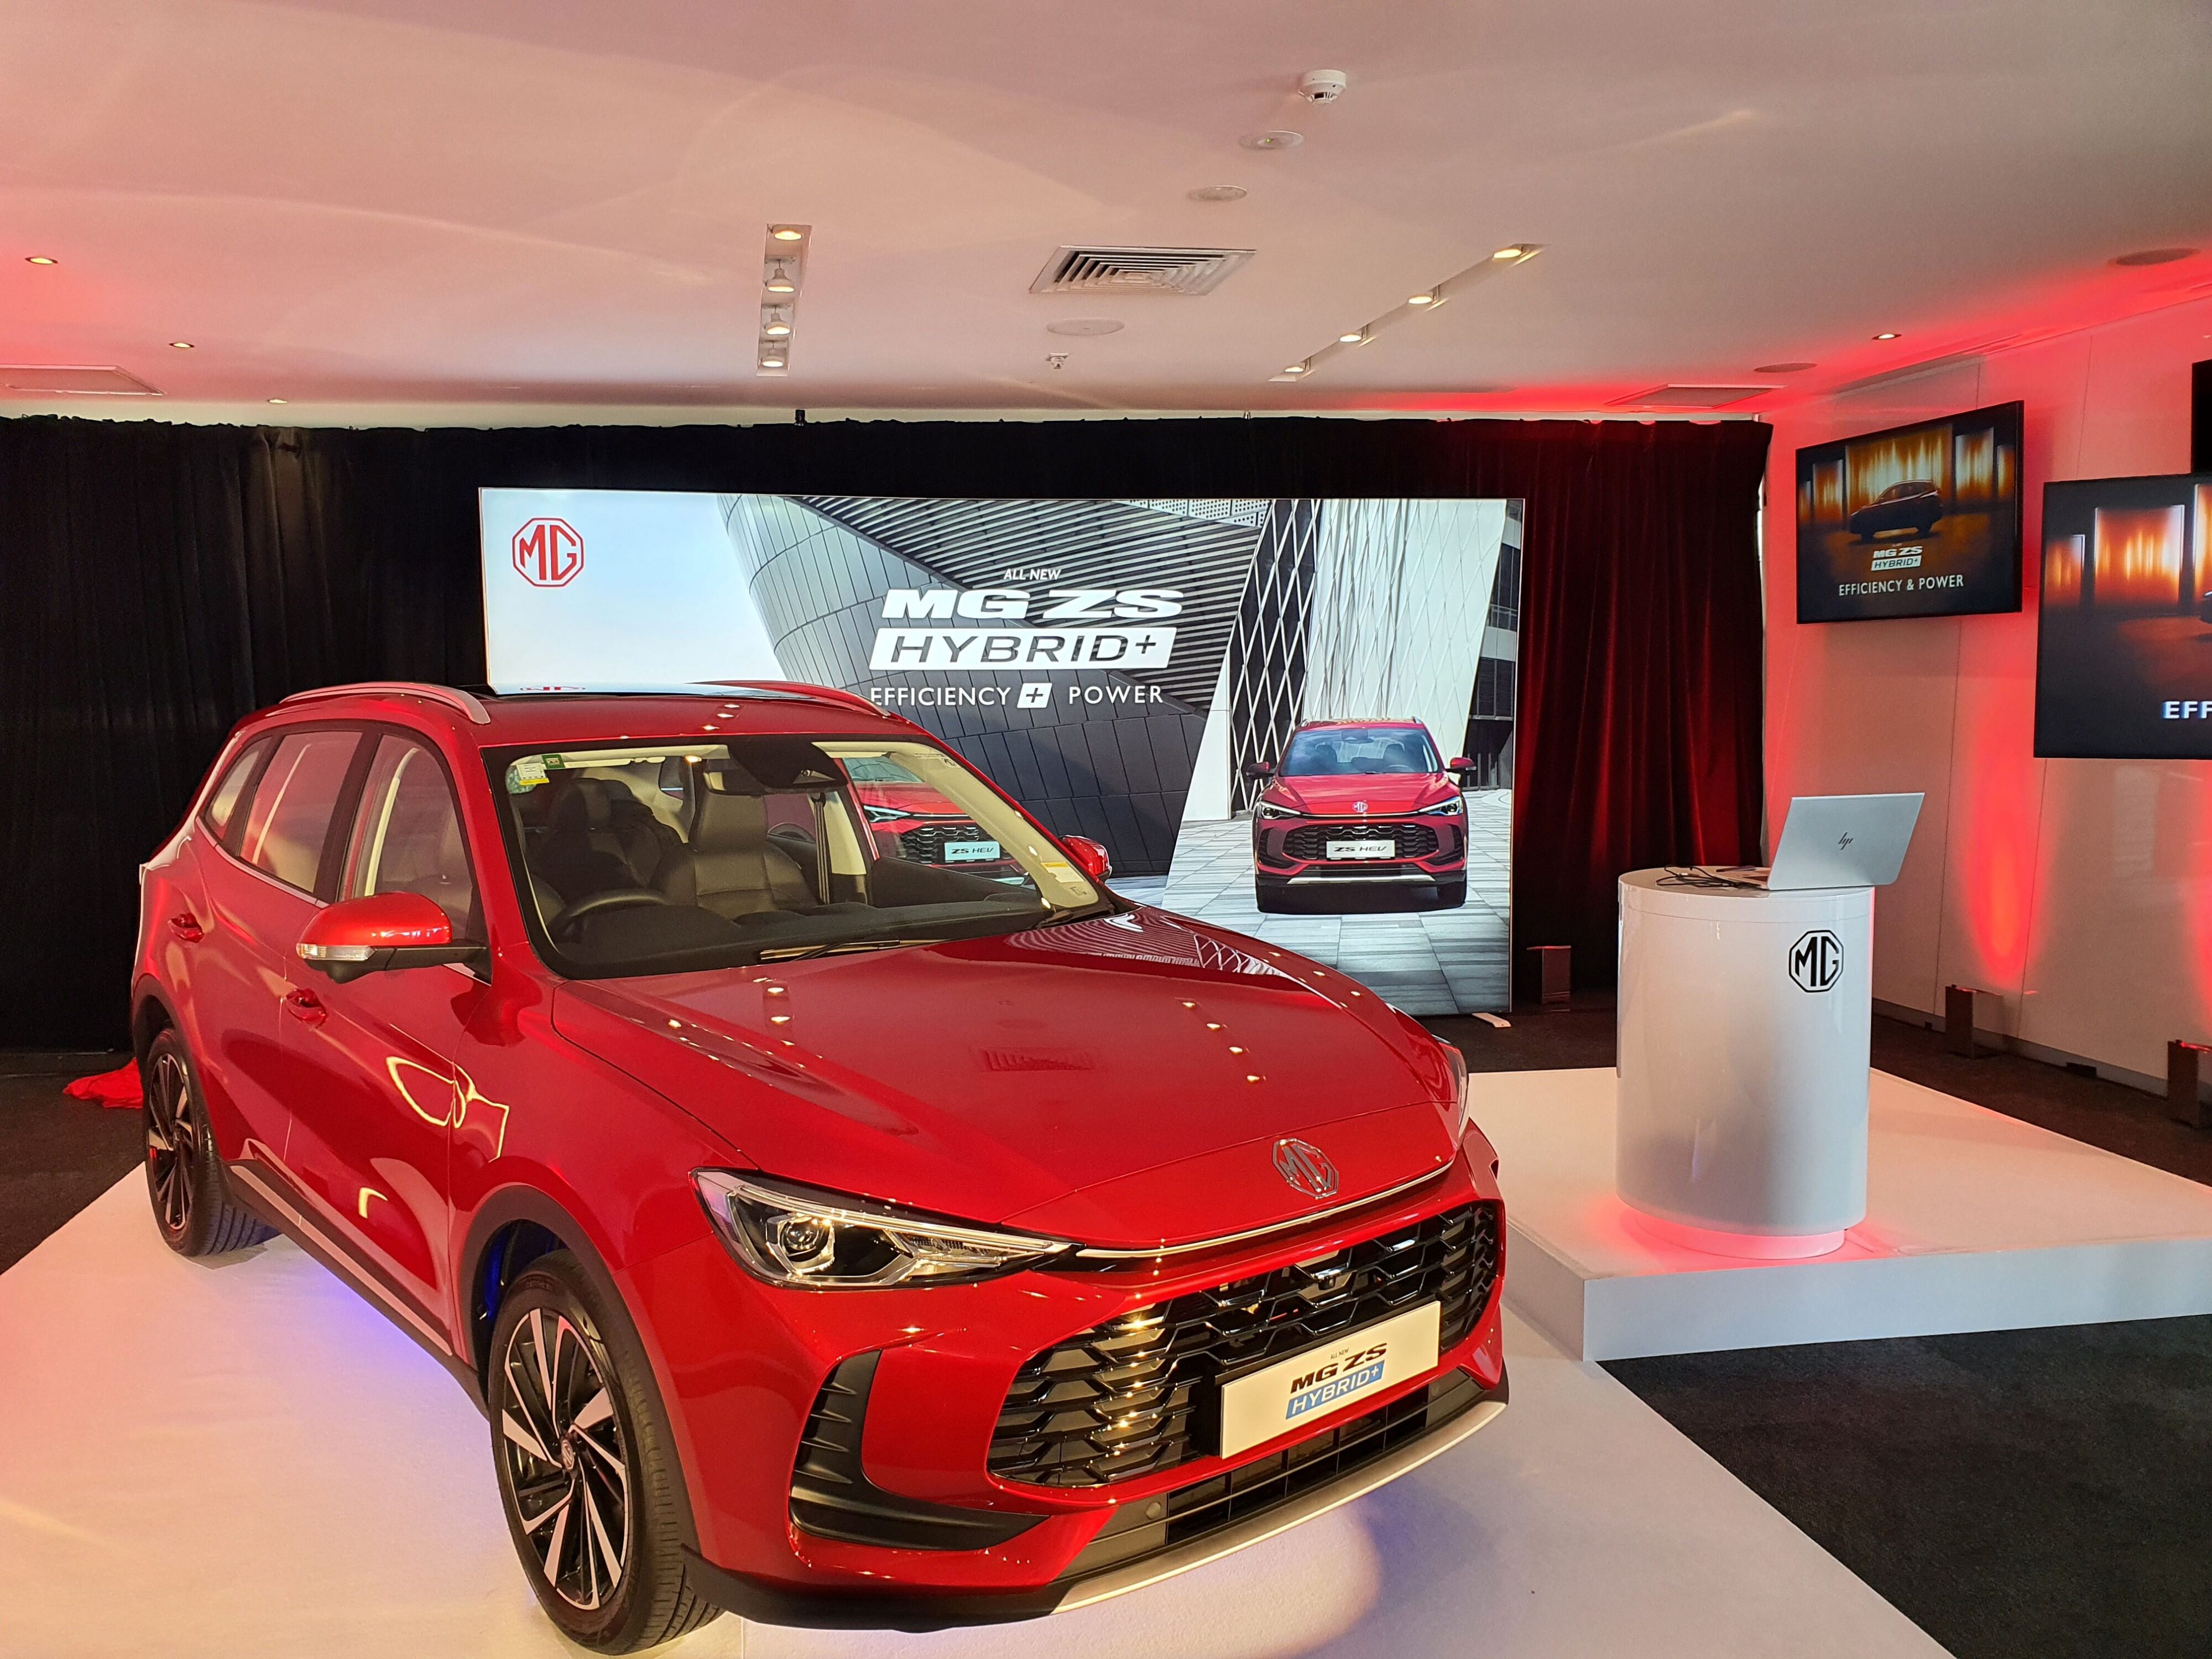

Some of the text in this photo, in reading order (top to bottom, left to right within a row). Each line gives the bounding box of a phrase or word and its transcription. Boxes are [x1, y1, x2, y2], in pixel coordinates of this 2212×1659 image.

[518, 523, 578, 582] MG
[1872, 546, 1923, 559] MG ZS
[1874, 558, 1918, 568] HYBRID+
[1003, 568, 1062, 580] ALL NEW
[1838, 575, 1964, 596] EFFICIENCY & POWER
[881, 589, 1184, 619] MG ZS
[890, 634, 1157, 664] HYBRID+
[870, 687, 1011, 706] EFFICIENCY
[1068, 685, 1163, 703] POWER
[1353, 801, 1367, 812] MG
[1793, 935, 1841, 987] MG
[1277, 1142, 1333, 1192] MG
[1338, 1348, 1349, 1357] NEW
[1290, 1343, 1387, 1394] MG ZS
[1291, 1365, 1379, 1415] HYBRID+
